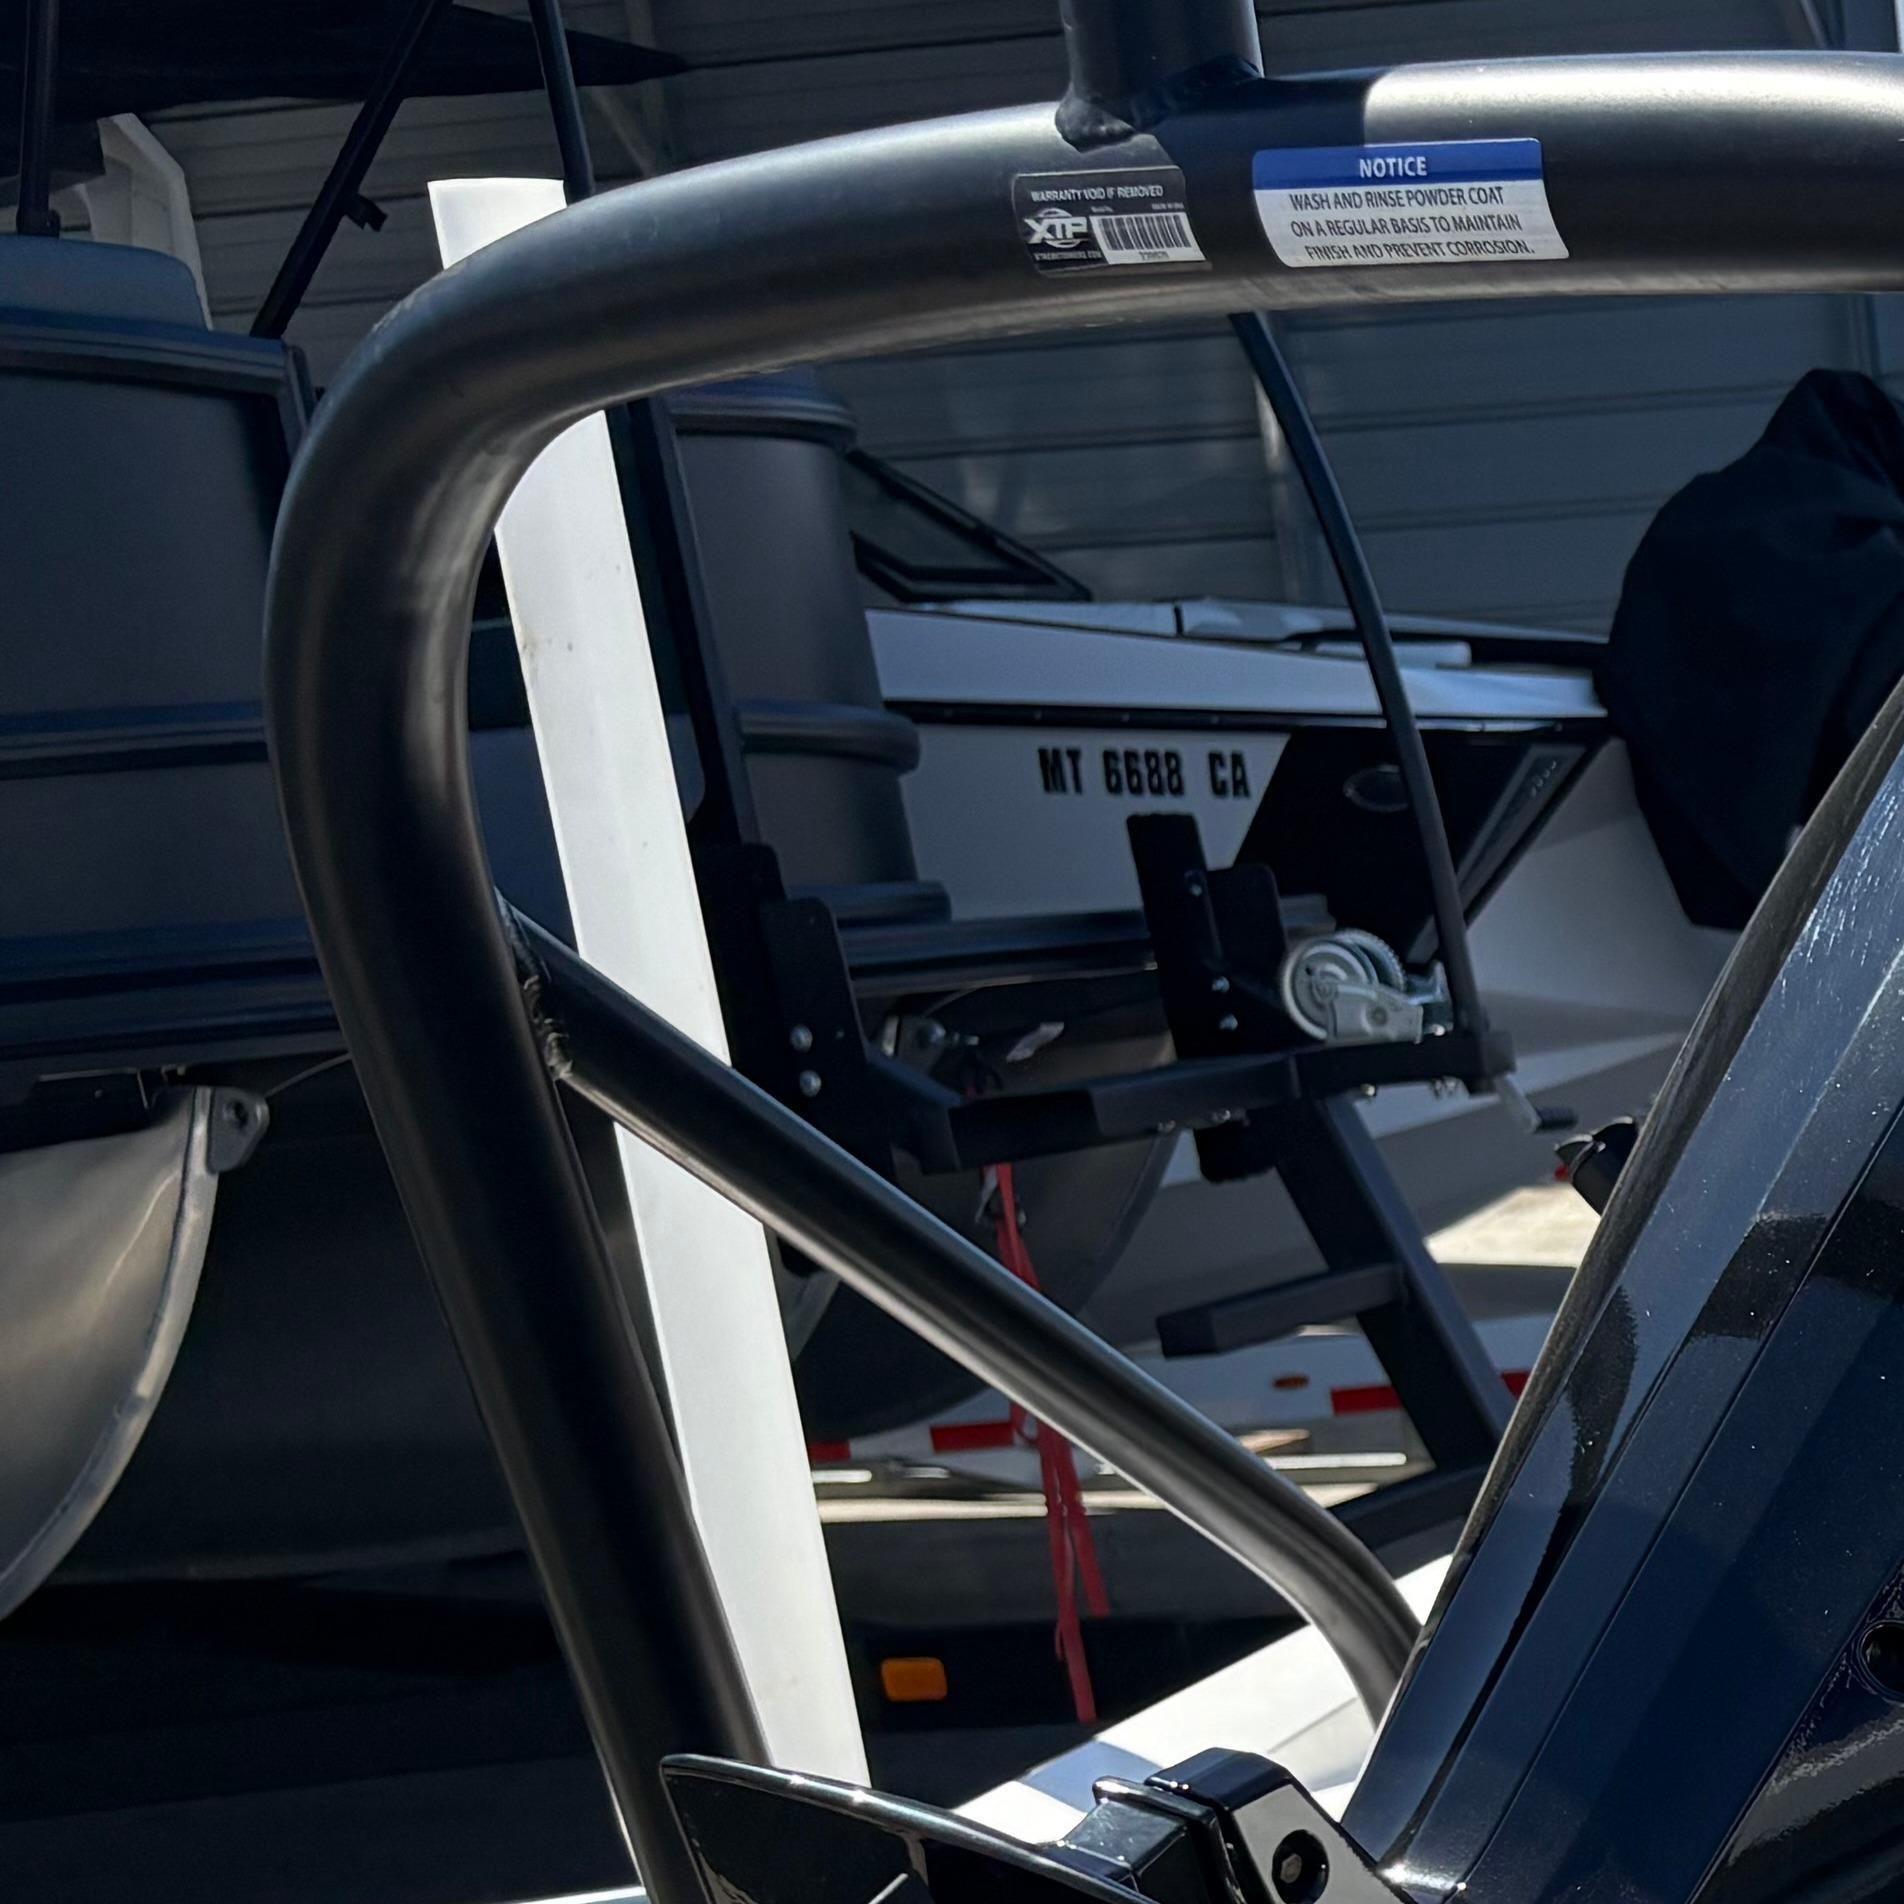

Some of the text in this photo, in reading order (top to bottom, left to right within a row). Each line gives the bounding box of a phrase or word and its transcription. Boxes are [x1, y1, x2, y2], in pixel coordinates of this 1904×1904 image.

[1359, 156, 1427, 178] NOTICE
[1117, 185, 1163, 199] REMOVED
[1289, 186, 1504, 211] WASH AND RINSE POWDER COAT
[1291, 214, 1523, 237] ON A REGULAR BASIS TO MAINTAIN
[1305, 239, 1535, 261] FINISH AND PREVENT CORROSION.
[1037, 748, 1250, 798] MT 6688 CA
